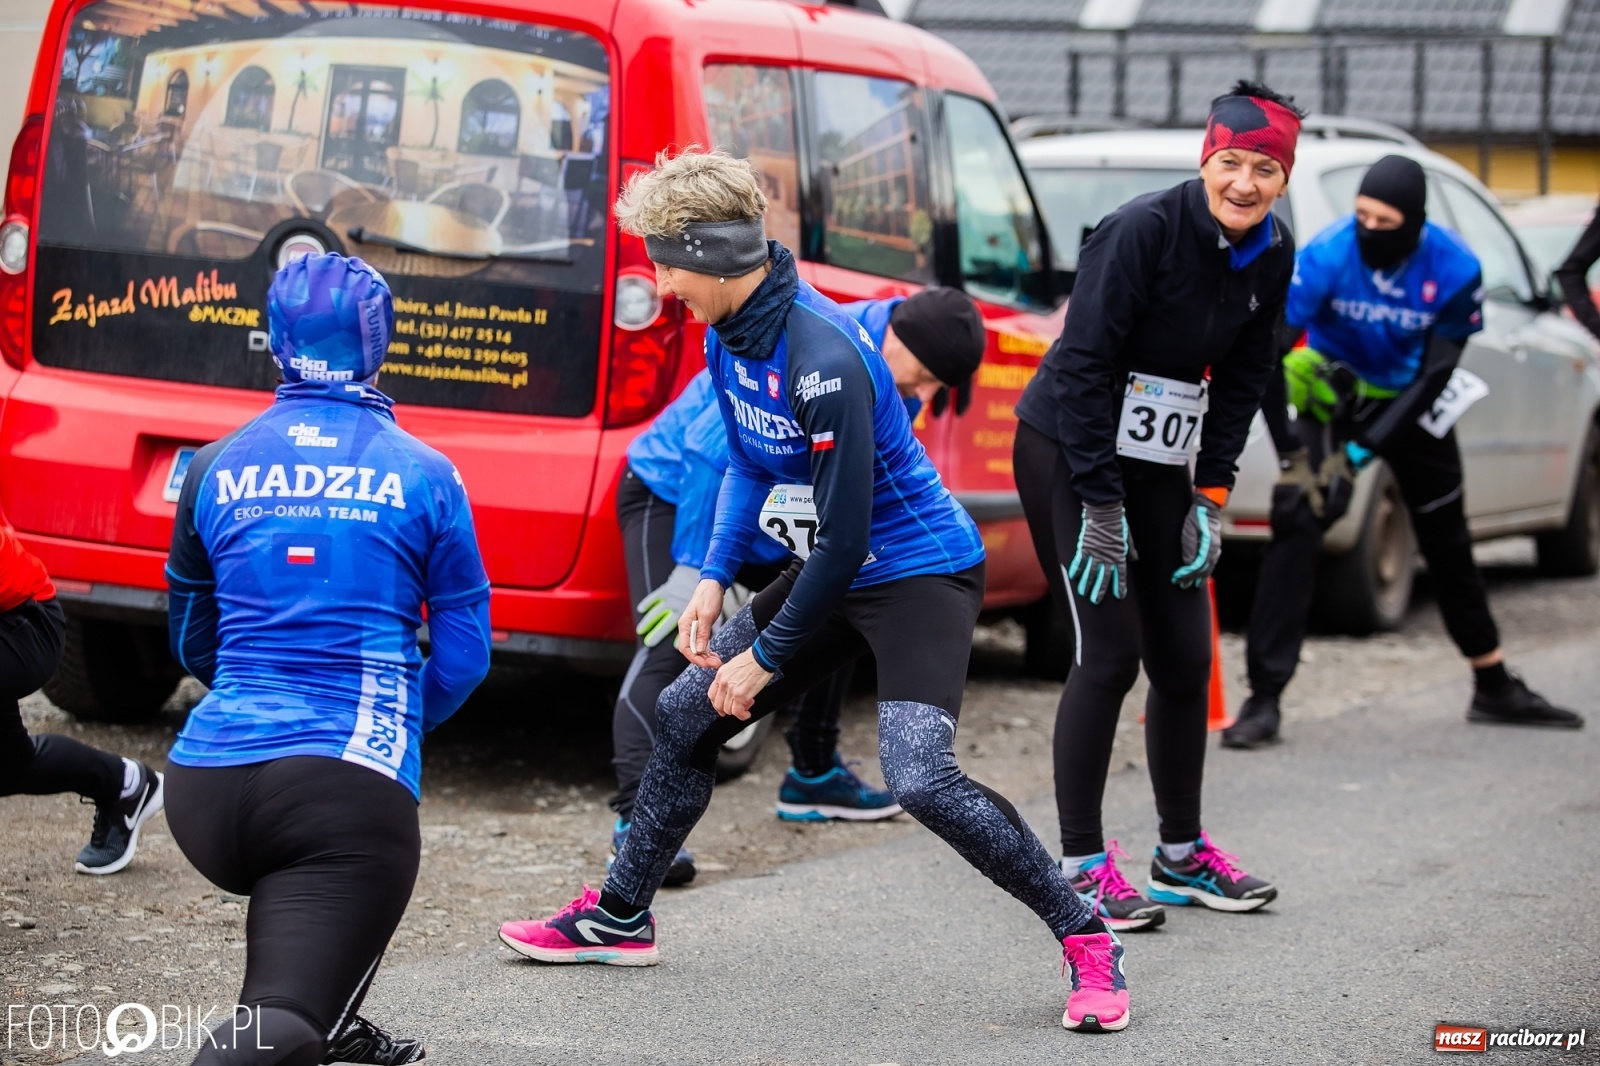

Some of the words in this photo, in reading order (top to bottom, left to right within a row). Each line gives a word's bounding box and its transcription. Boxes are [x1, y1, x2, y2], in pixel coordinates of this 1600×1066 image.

[49, 280, 136, 328] Zajazd
[139, 268, 237, 309] Malibu
[763, 443, 794, 455] TEAM
[1127, 405, 1199, 450] 307
[215, 463, 407, 510] MADZIA
[328, 506, 378, 523] TEAM
